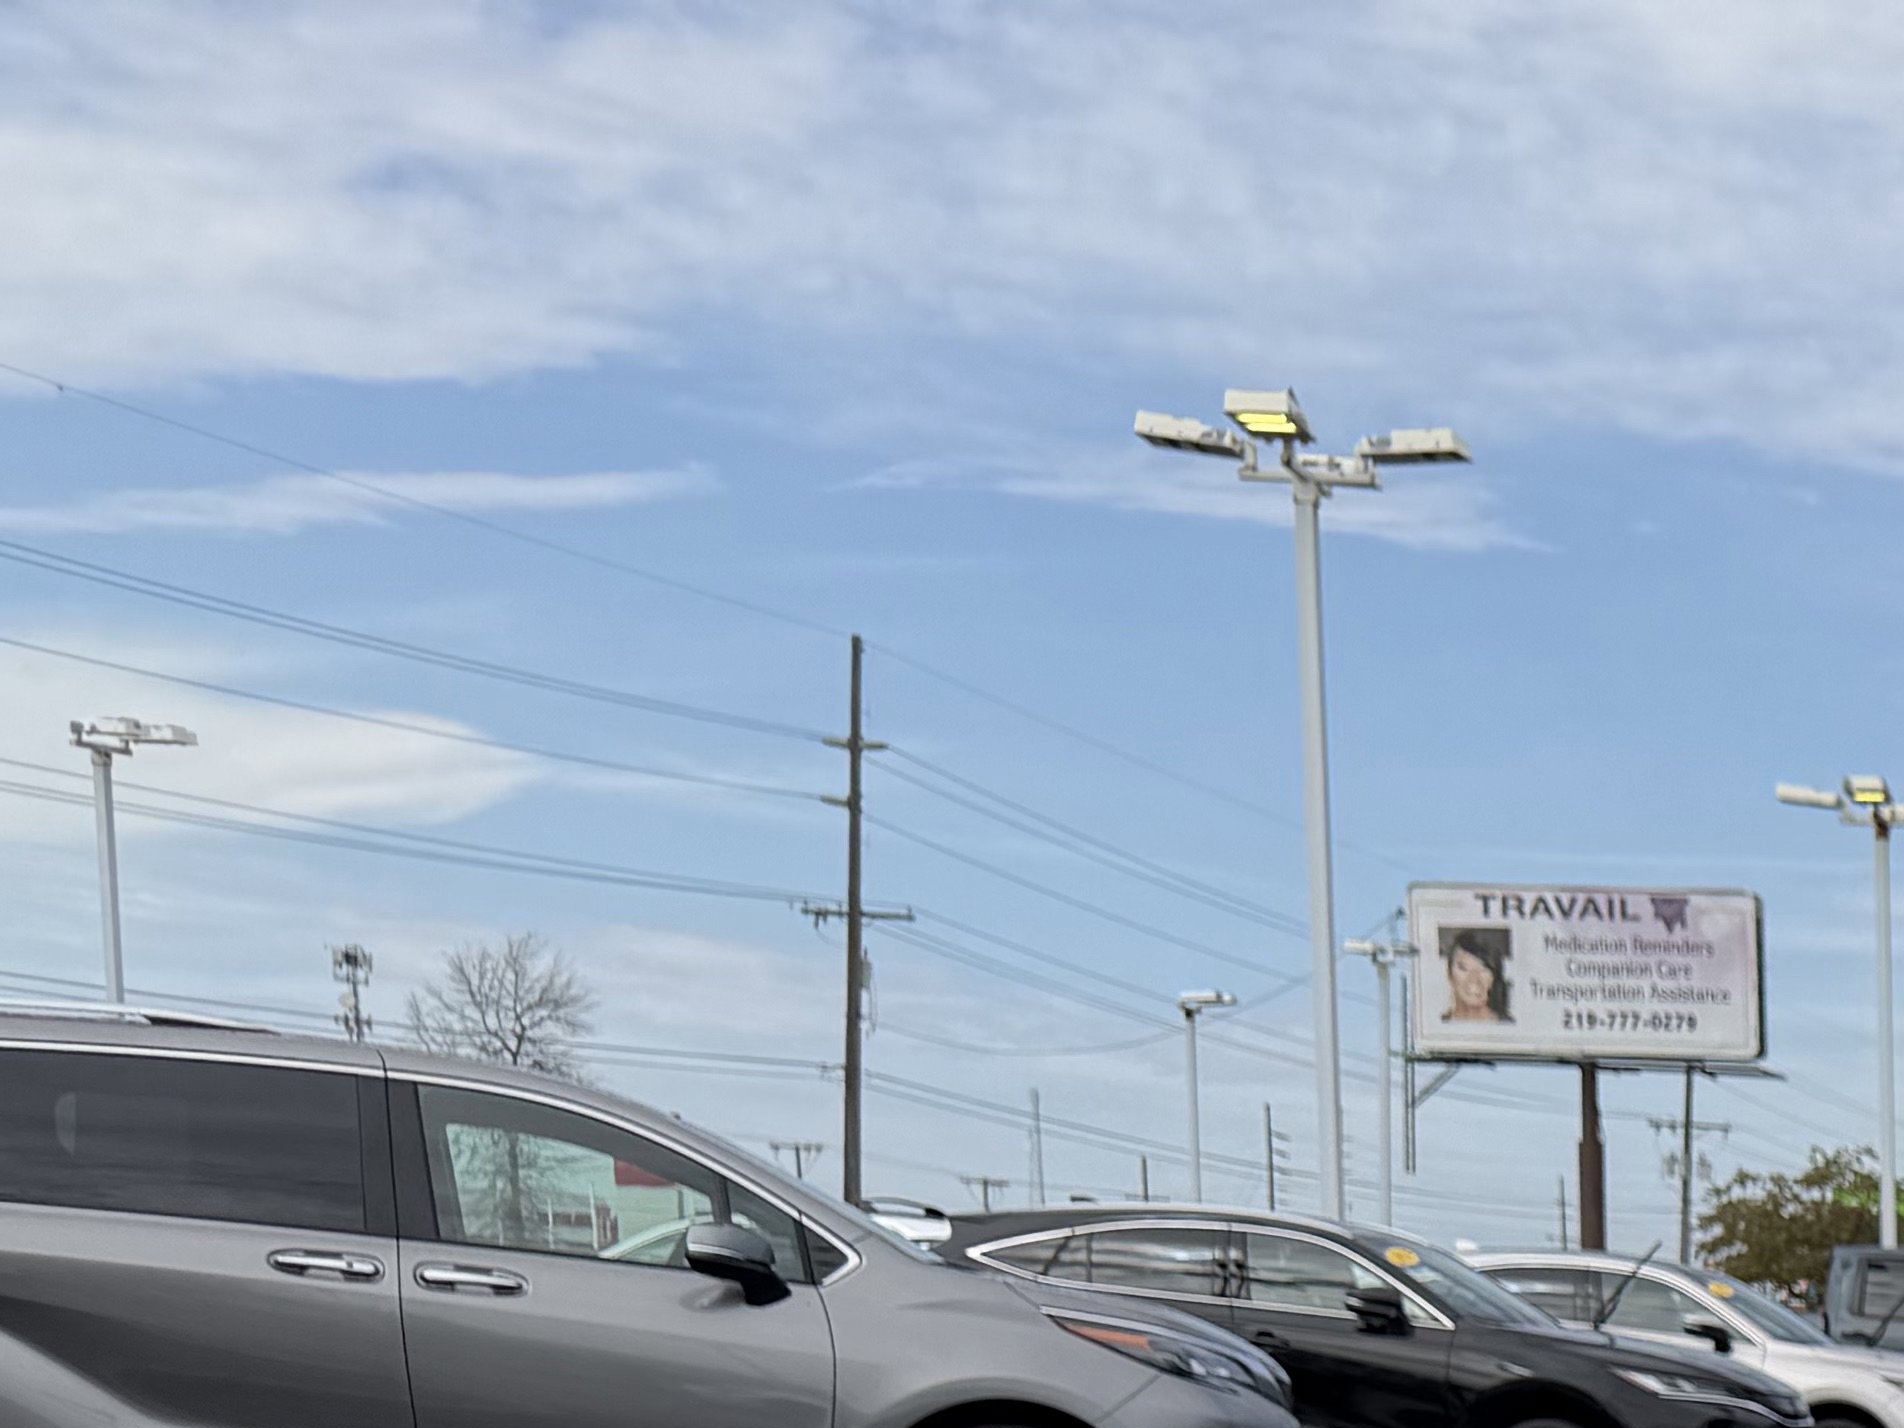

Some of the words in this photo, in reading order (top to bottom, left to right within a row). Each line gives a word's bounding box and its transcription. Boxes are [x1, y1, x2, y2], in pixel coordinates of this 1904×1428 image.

[1474, 893, 1641, 922] TRAVAIL
[1543, 934, 1627, 955] Medication
[1631, 936, 1716, 959] Reminders
[1566, 957, 1652, 980] Companion
[1655, 960, 1692, 981] Care
[1529, 976, 1645, 1004] Transportation
[1649, 980, 1732, 1005] Assistance
